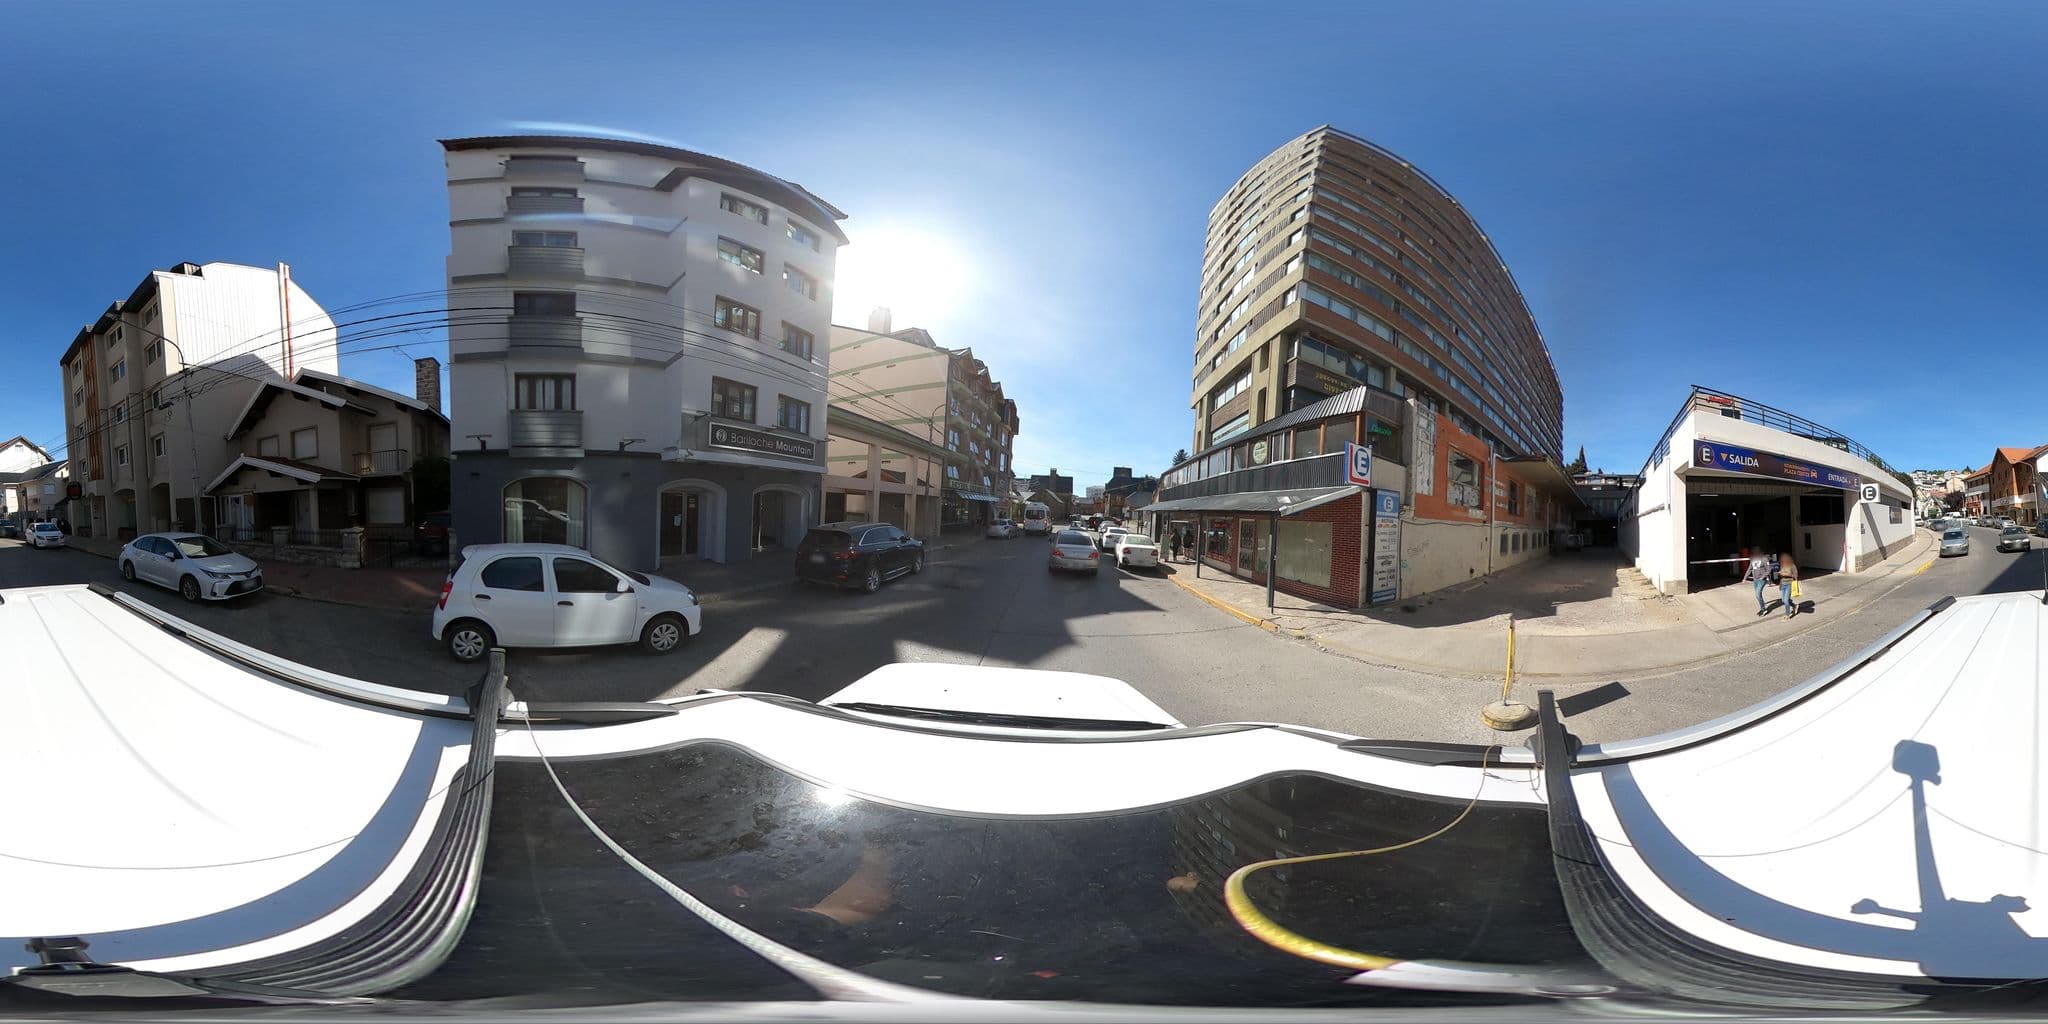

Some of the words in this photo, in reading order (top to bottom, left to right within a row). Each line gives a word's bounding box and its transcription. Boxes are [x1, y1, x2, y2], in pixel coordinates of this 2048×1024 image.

[730, 432, 774, 449] Bariloche
[775, 440, 812, 456] Mountain
[1702, 447, 1711, 462] E
[1729, 454, 1760, 468] SALIDA
[1360, 451, 1369, 475] E
[1827, 473, 1848, 484] ENTRADA
[1865, 487, 1874, 499] E
[1385, 498, 1392, 510] E
